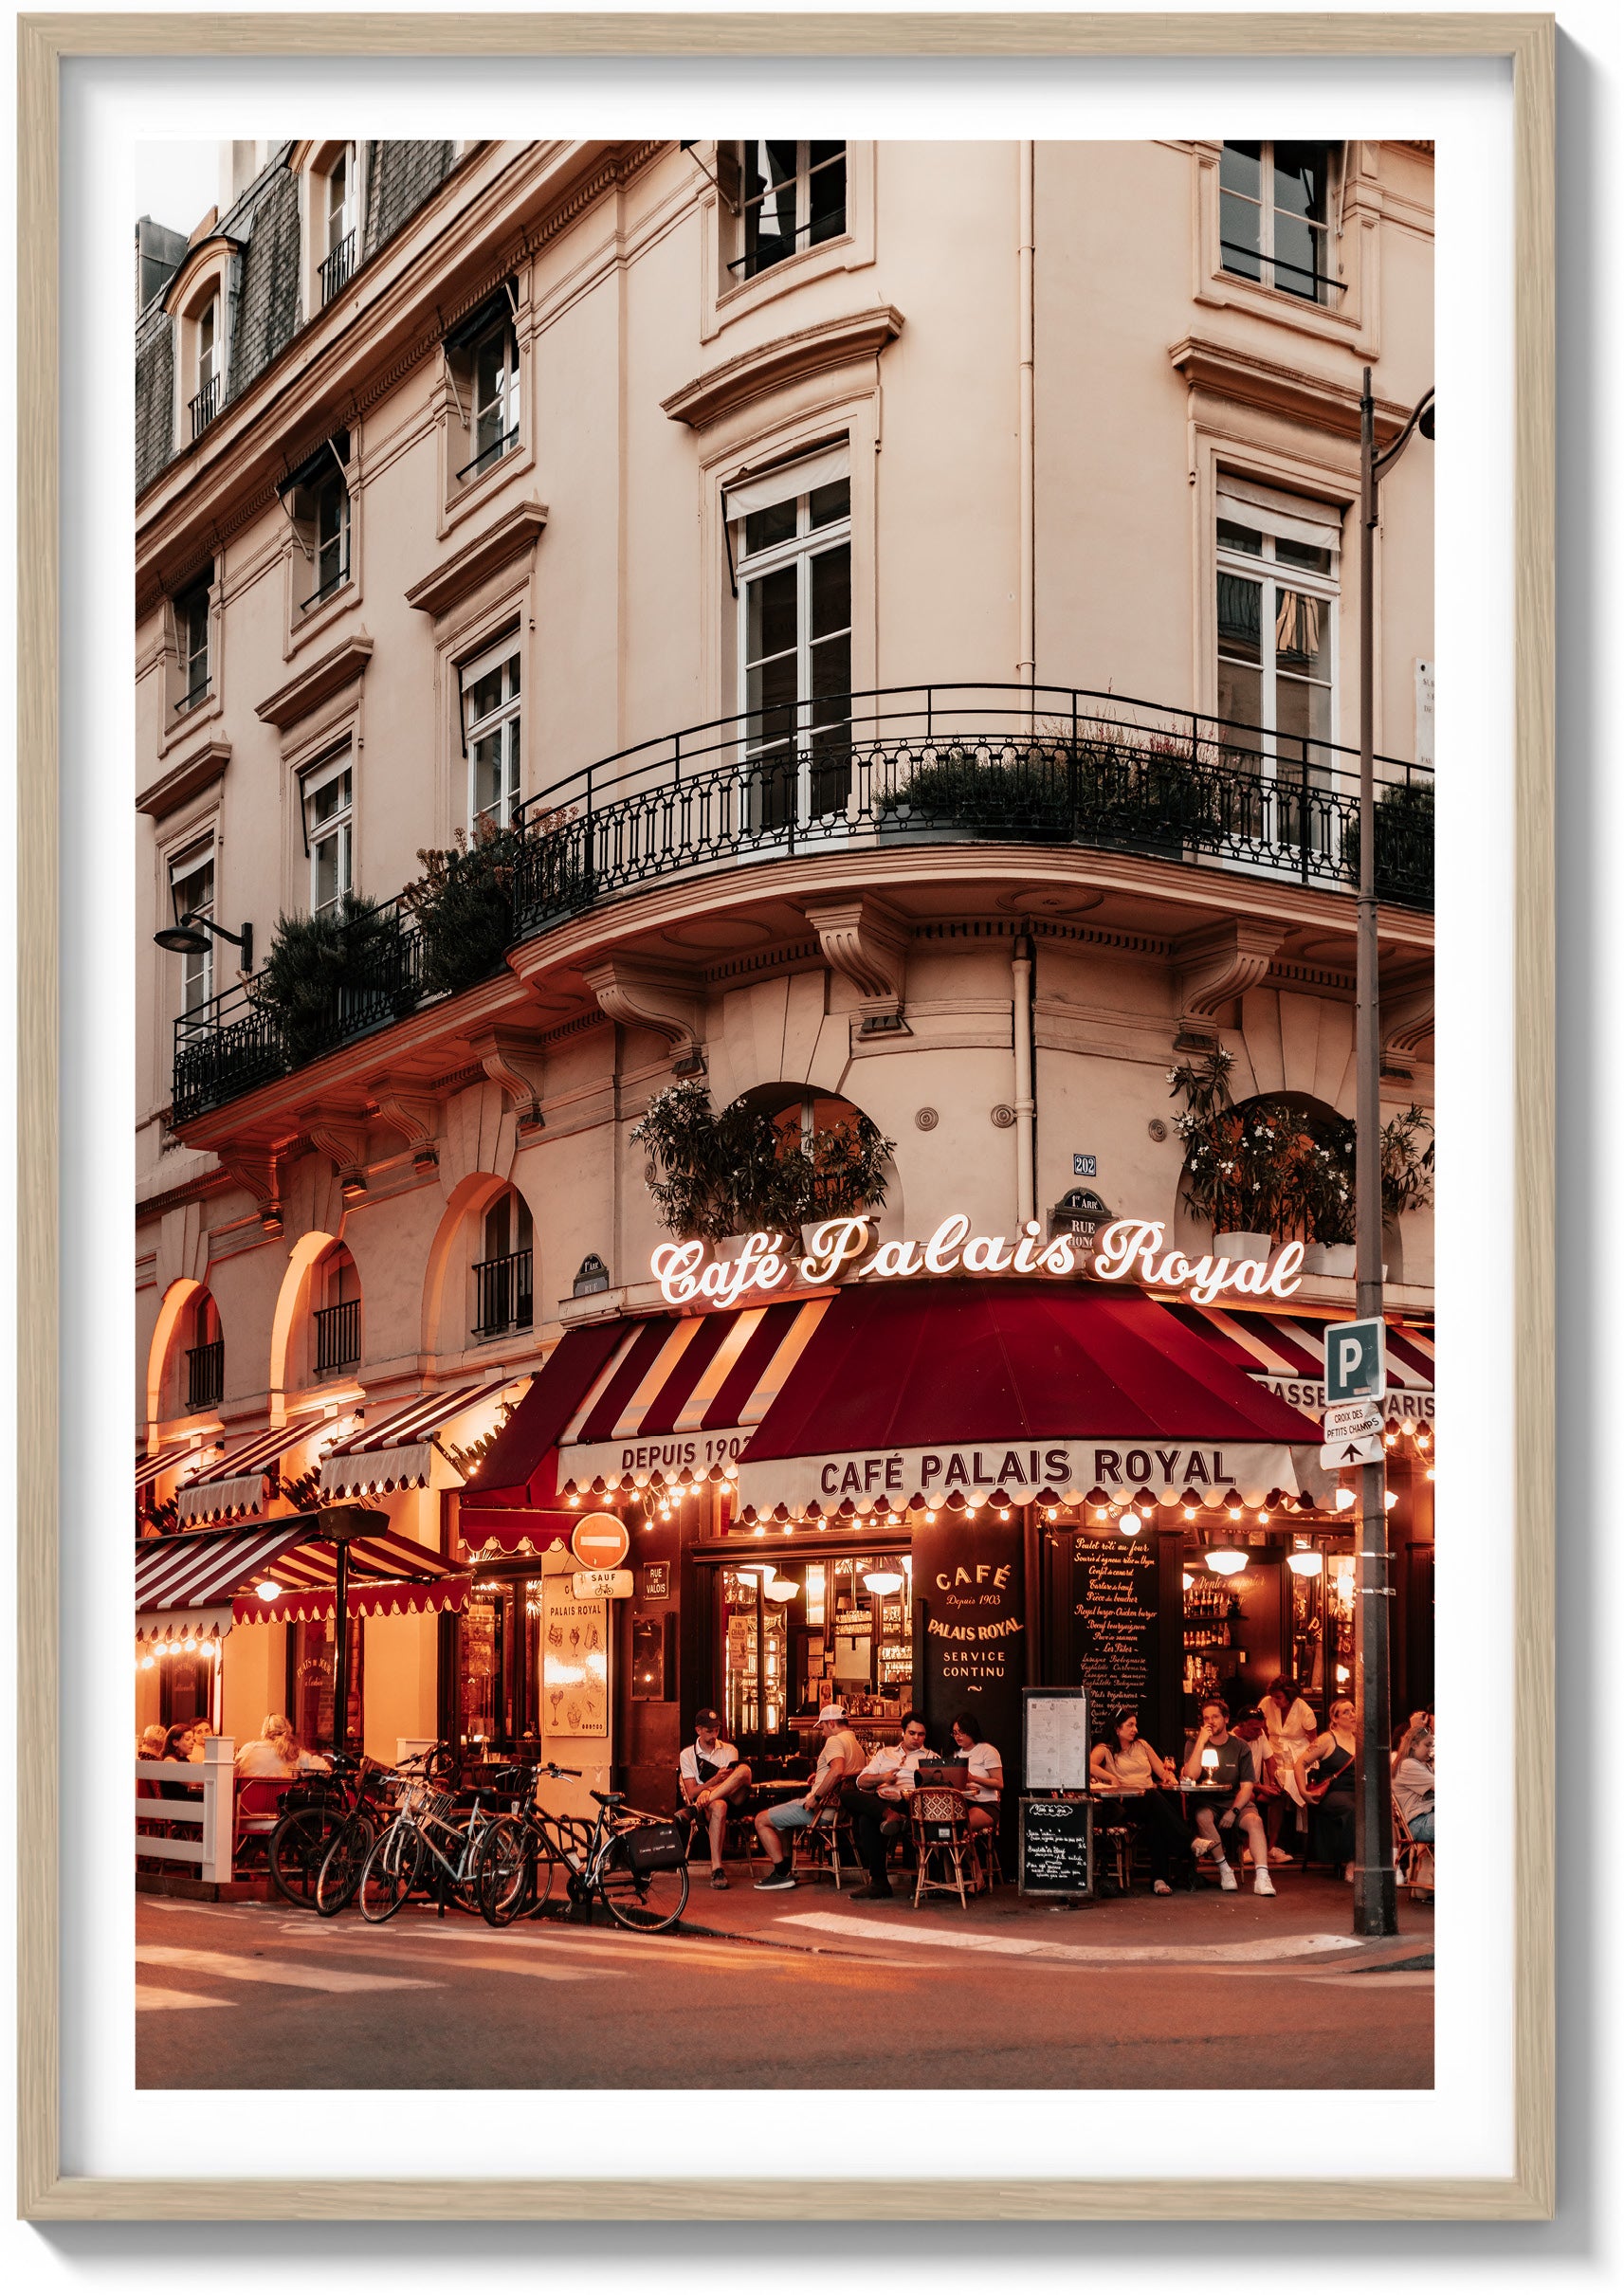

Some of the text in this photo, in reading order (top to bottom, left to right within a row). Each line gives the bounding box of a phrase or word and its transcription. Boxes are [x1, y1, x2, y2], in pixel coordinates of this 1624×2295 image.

[1076, 1157, 1094, 1174] 202
[1071, 1219, 1095, 1234] RUE
[650, 1212, 1305, 1307] Café Palais Royal
[1339, 1338, 1363, 1388] P
[1387, 1394, 1434, 1418] ARIS
[1334, 1409, 1364, 1424] CROIX DES
[1327, 1418, 1380, 1438] PETITS CHAMPS
[622, 1442, 696, 1470] DEPUIS
[820, 1448, 1237, 1495] CAFÉ PALAIS ROYAL
[1128, 1540, 1149, 1557] four
[592, 1574, 616, 1582] SAUF
[649, 1568, 663, 1578] RUE
[936, 1564, 1012, 1591] CAFÉ
[647, 1583, 666, 1594] VALOIS
[550, 1604, 601, 1616] PALAIS ROYAL
[946, 1594, 1001, 1610] Depuis 1903
[927, 1616, 1024, 1642] PALAIS ROYAL
[943, 1651, 1006, 1662] SERVICE
[942, 1667, 1005, 1677] CONTINU
